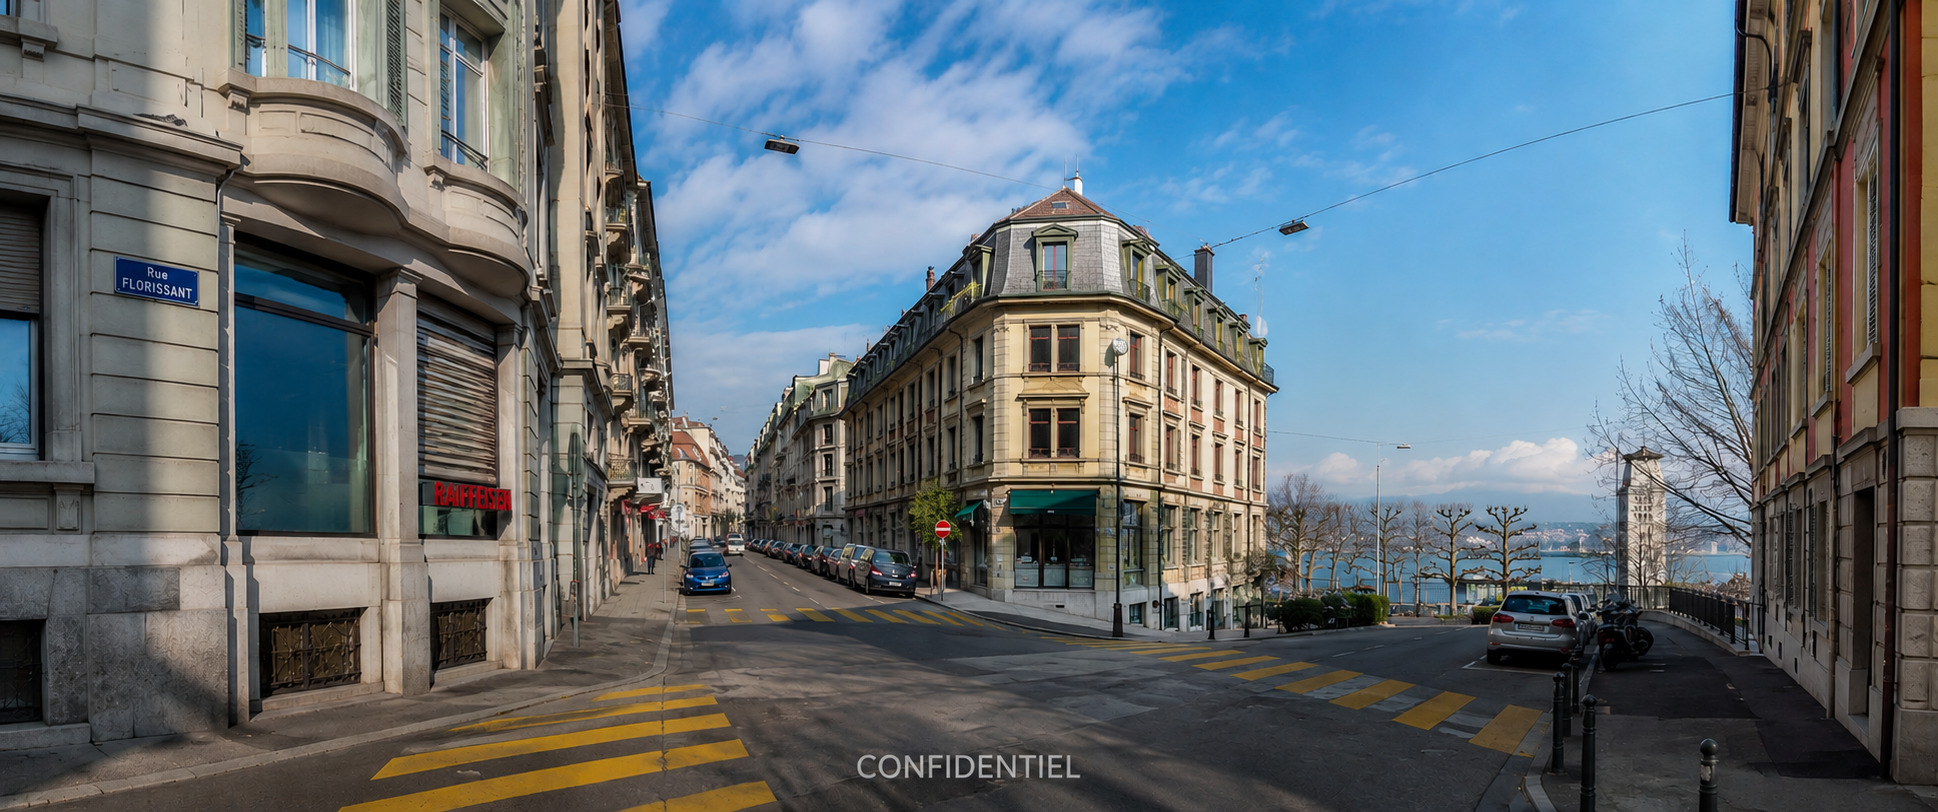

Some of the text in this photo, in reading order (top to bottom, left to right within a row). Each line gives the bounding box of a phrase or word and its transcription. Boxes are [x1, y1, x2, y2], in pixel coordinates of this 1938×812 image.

[147, 266, 168, 280] Rue
[122, 277, 192, 299] FLORISSANT
[434, 481, 512, 511] RAIFFEISEN
